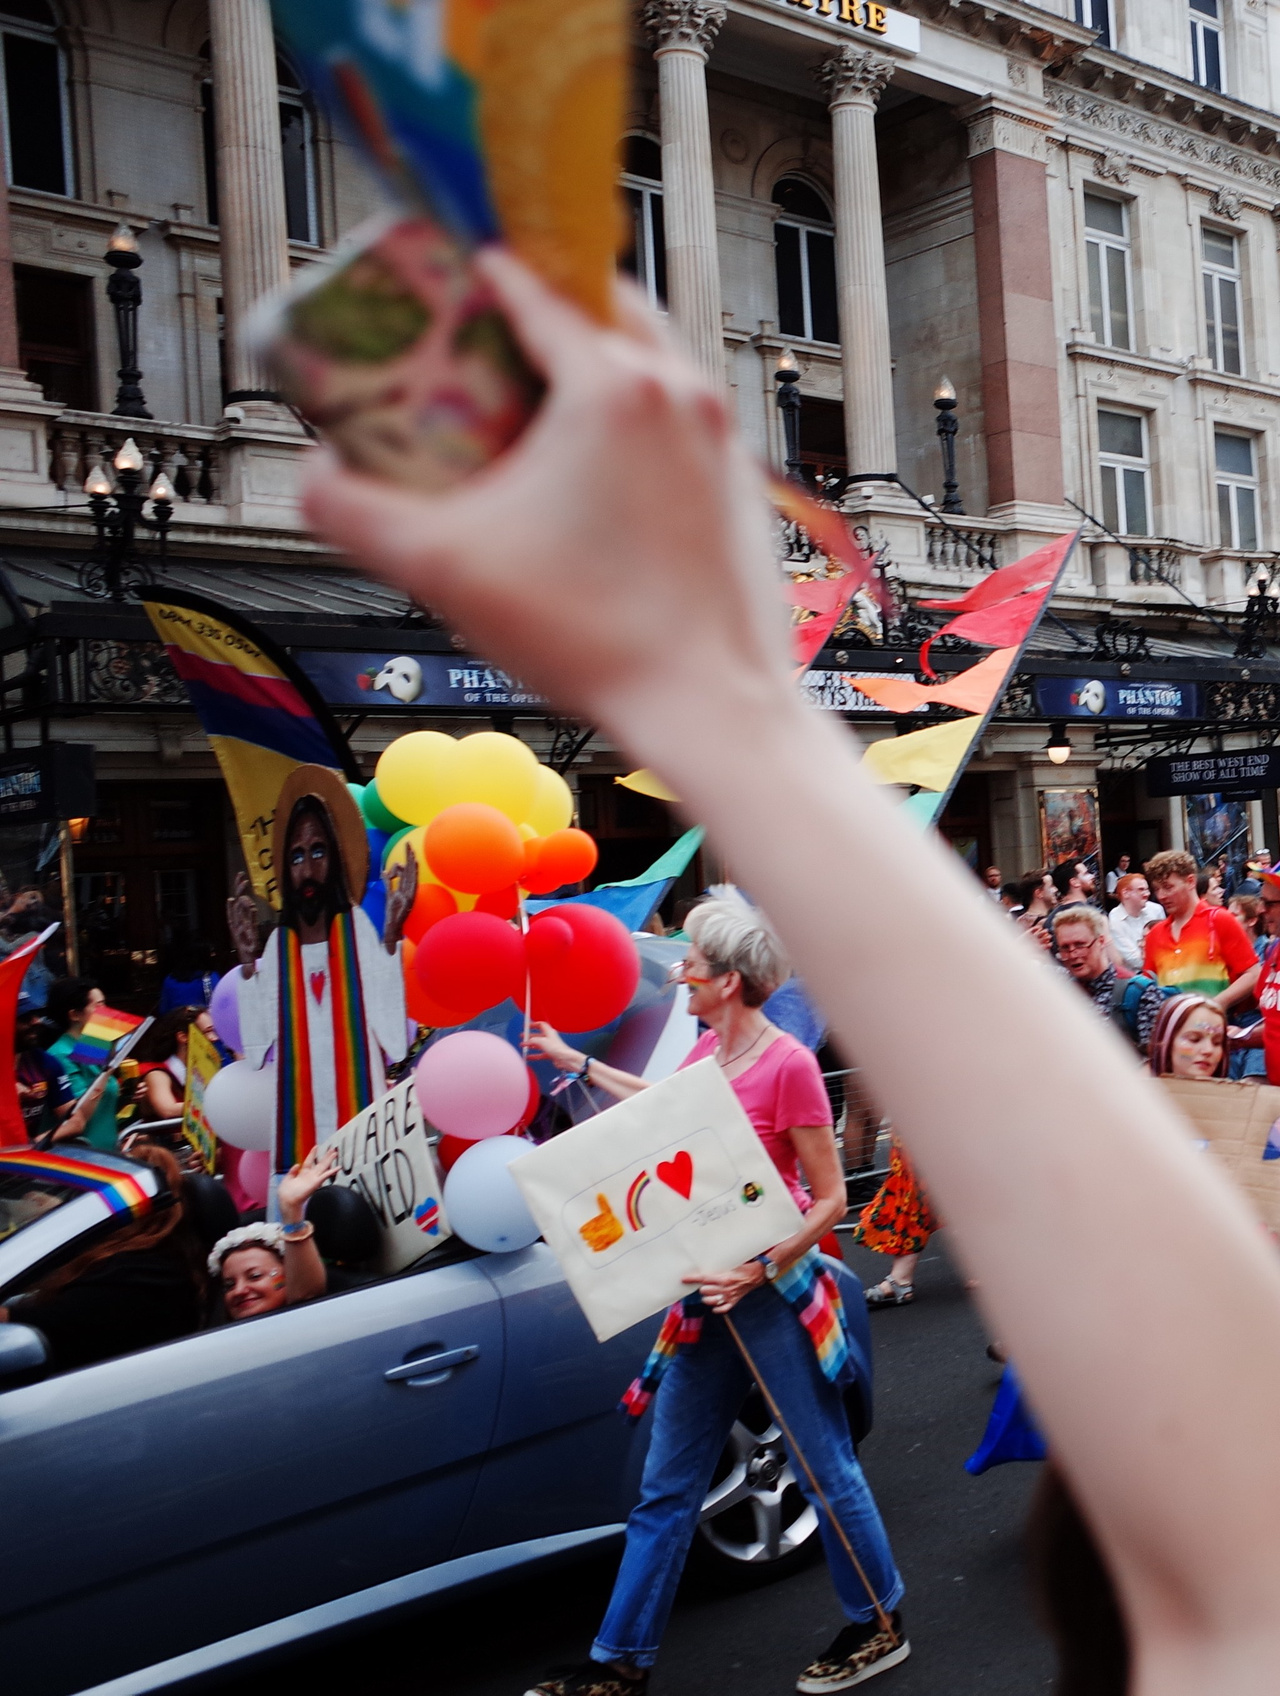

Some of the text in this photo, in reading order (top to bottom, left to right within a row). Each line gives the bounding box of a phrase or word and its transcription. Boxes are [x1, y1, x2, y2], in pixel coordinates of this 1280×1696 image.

[484, 692, 510, 703] THE
[1117, 687, 1183, 706] PHANTOM
[1169, 754, 1270, 773] THE BEST WEST END
[1171, 765, 1269, 783] SHOW OF ALL TIME
[364, 1085, 416, 1165] ARE
